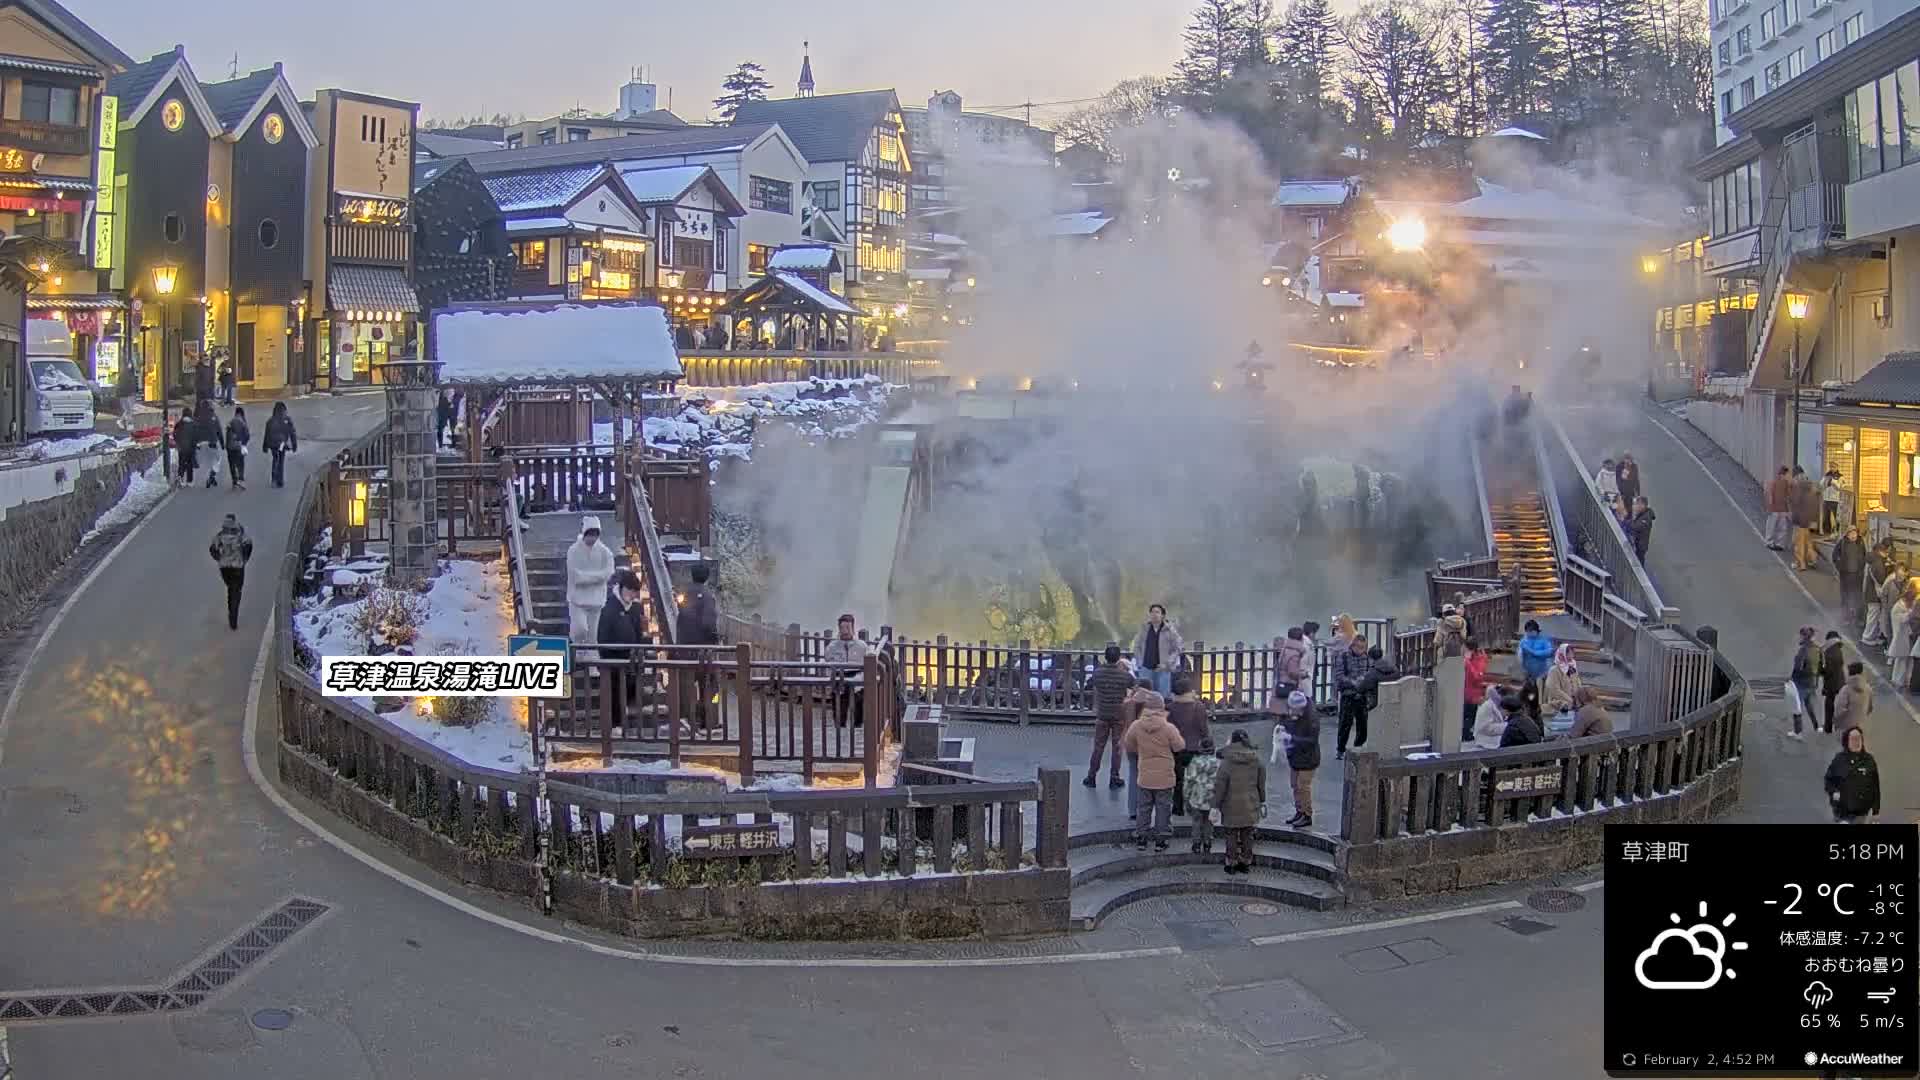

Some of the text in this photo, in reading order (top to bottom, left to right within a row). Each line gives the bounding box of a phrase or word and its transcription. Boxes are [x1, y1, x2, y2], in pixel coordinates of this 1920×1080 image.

[1513, 772, 1561, 792] 東京 軽井沢
[710, 831, 778, 850] 東京 軽井沢
